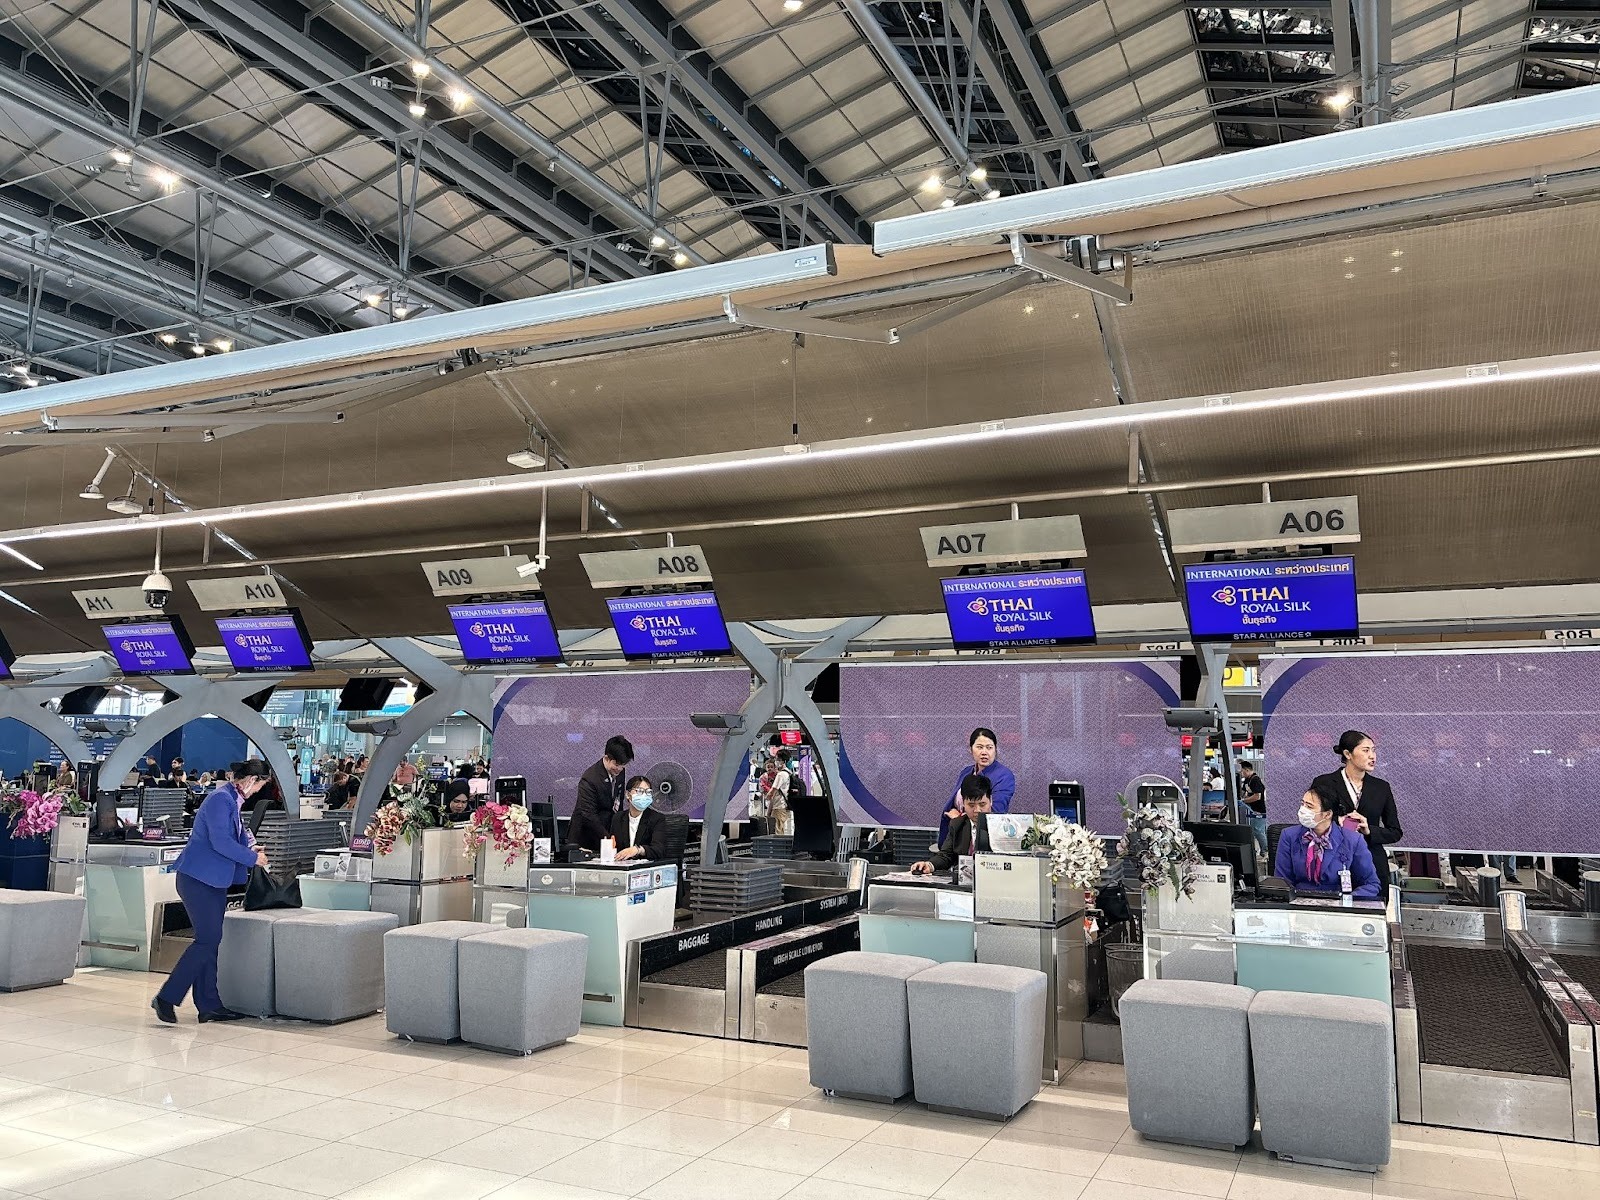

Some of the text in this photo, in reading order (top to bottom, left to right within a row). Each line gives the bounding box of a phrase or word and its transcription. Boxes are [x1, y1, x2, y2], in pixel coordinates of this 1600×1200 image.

[1279, 509, 1344, 534] A06
[937, 533, 986, 555] A07
[658, 555, 699, 574] A08
[1187, 563, 1350, 579] INTERNATIONAL ระหว่างประเทศ
[437, 568, 473, 587] A09
[944, 576, 1082, 592] INTERNATIONAL ระหว่างประเทศ
[244, 583, 276, 600] A10
[1237, 586, 1289, 601] THAI
[85, 596, 113, 611] A11
[609, 601, 665, 611] INTERNATIONAL
[988, 598, 1034, 611] THAI
[1241, 601, 1311, 613] ROYAL SILK
[450, 609, 501, 617] INTERNATIONAL
[993, 611, 1053, 622] ROYAL SILK
[646, 615, 681, 628] THAI
[1242, 615, 1277, 626] ชั้นธุรกิจ
[484, 623, 516, 634] THAI
[651, 627, 697, 637] ROYAL SILK
[995, 624, 1025, 634] ชั้นธุรกิจ
[1259, 631, 1304, 639] ALLIANCE
[132, 640, 154, 650] THAI
[246, 635, 272, 645] THAI
[514, 635, 530, 643] SILK
[678, 932, 710, 951] BAGGAGE
[755, 915, 783, 931] HANDLING
[820, 898, 837, 910] SYSTEM
[773, 954, 788, 965] WEIGH
[788, 948, 802, 961] SCALE
